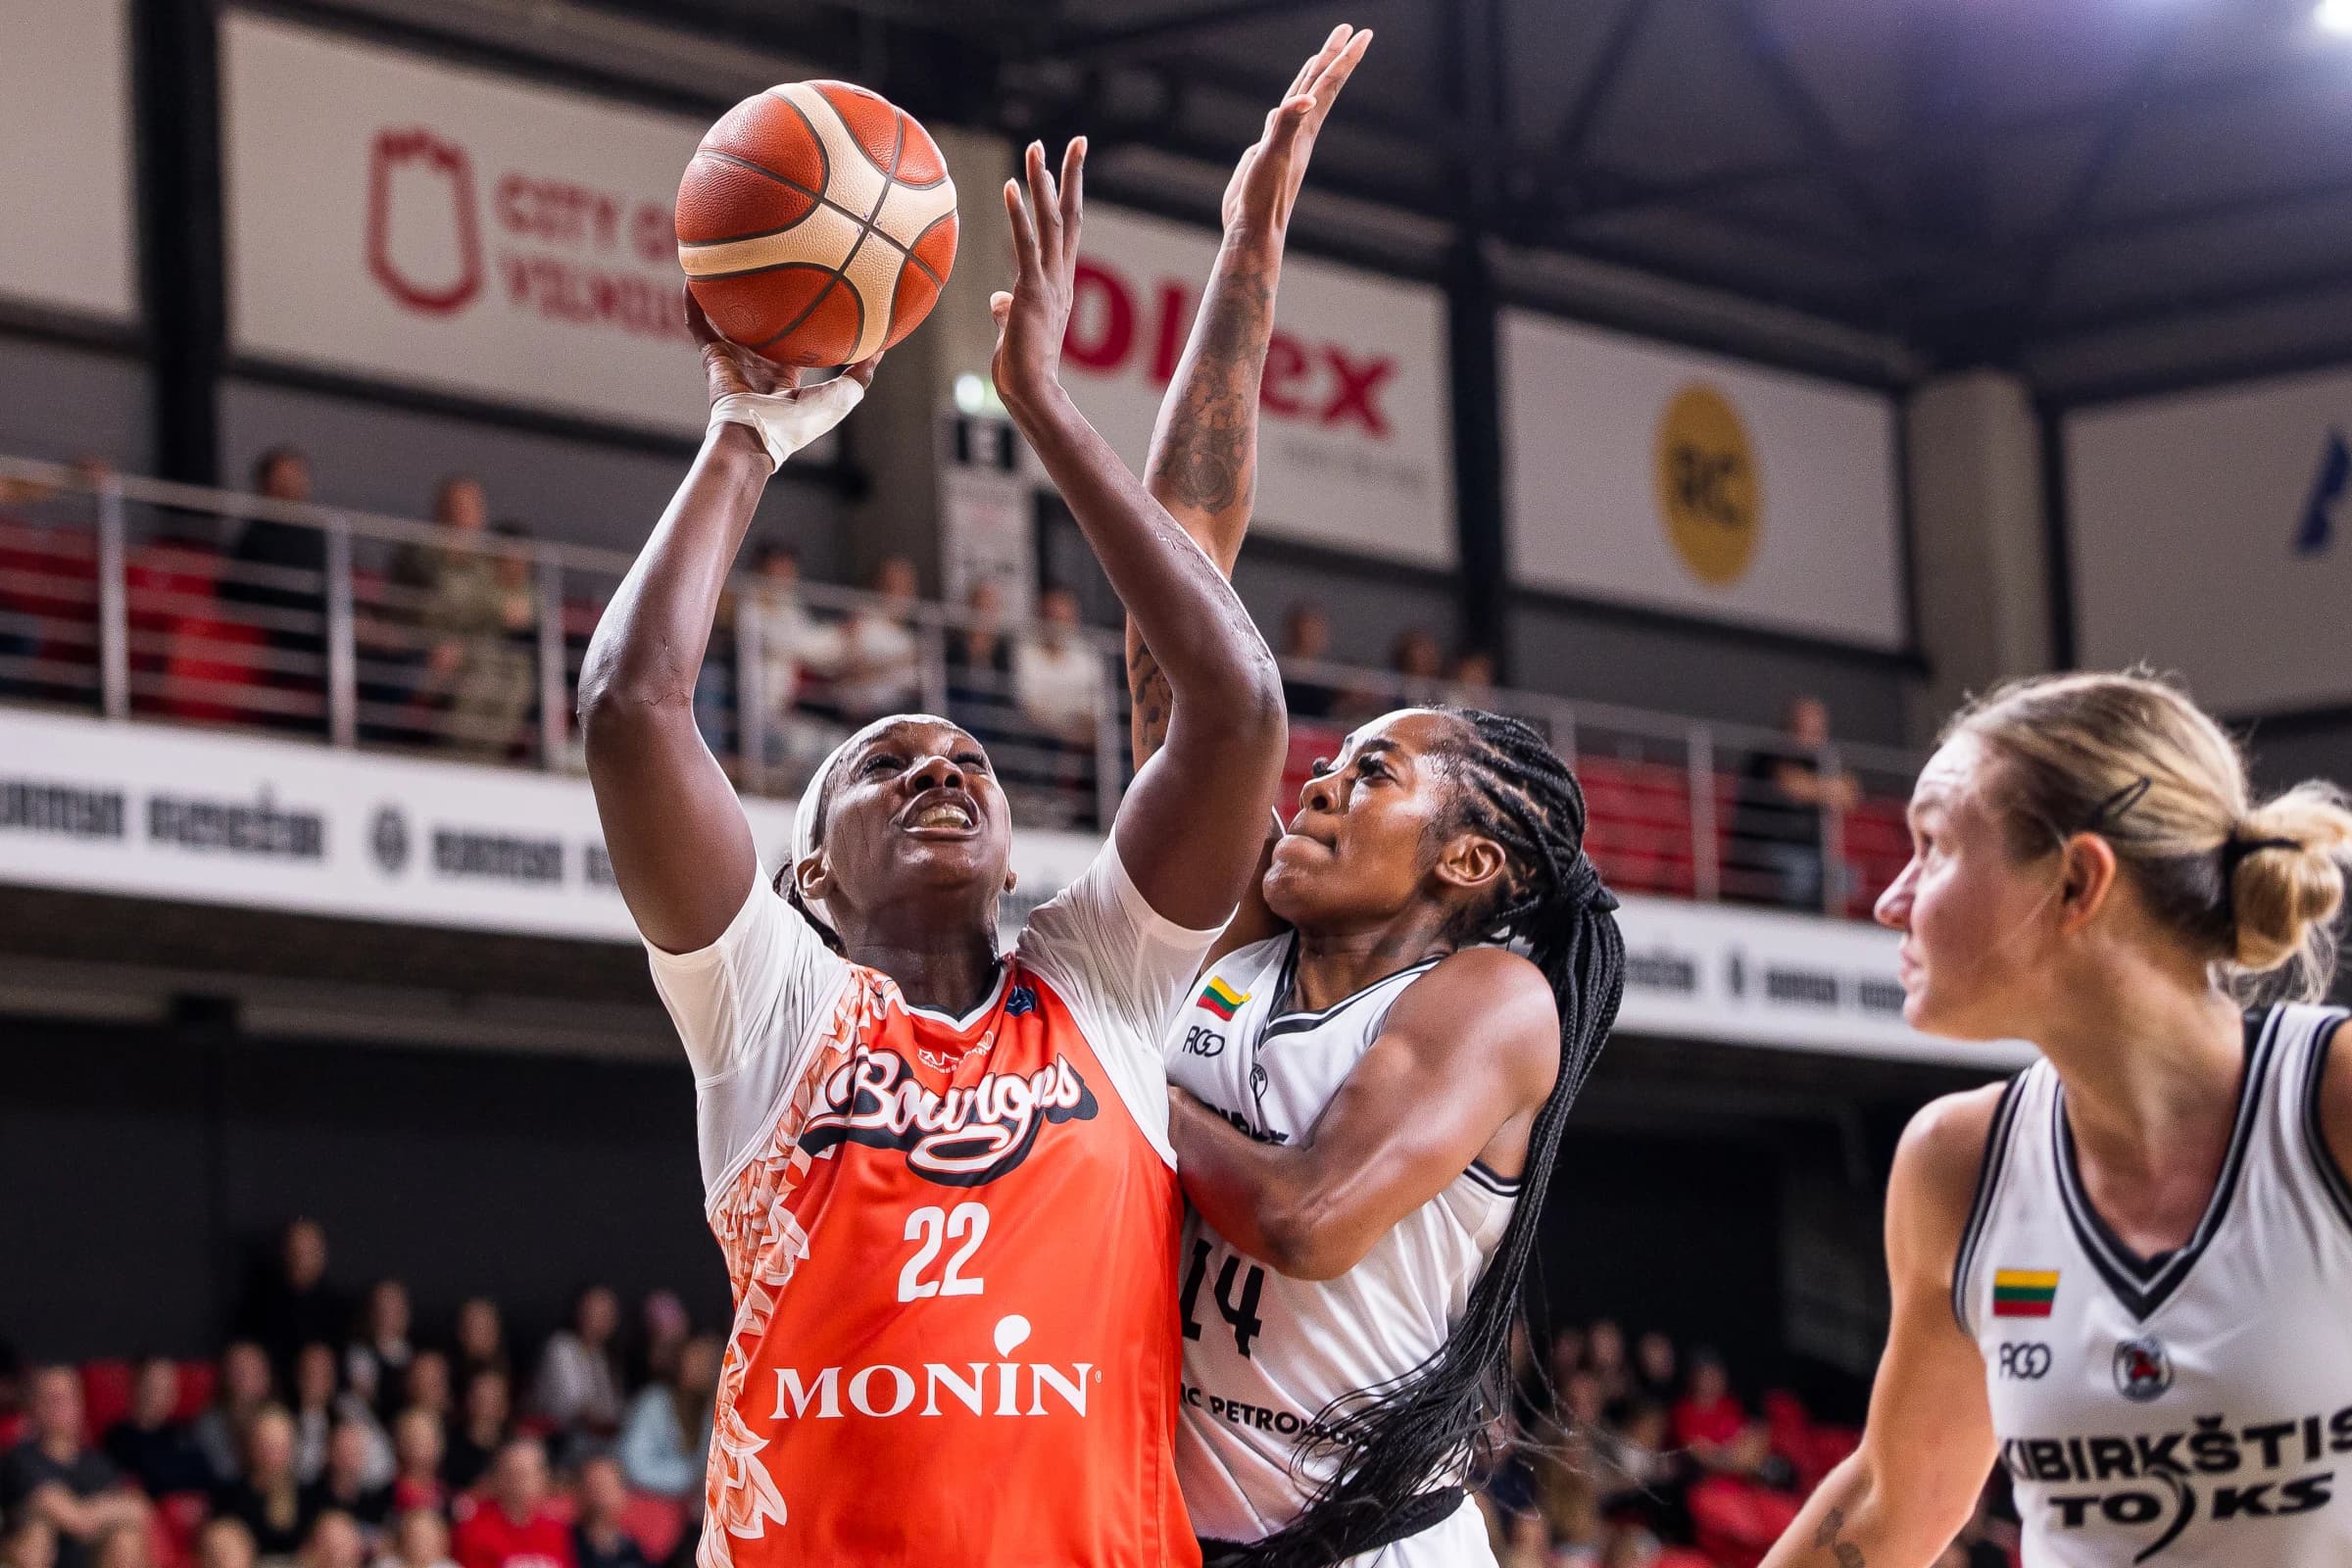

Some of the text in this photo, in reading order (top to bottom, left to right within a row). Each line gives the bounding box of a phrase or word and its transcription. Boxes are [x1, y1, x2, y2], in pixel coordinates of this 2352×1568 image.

[632, 202, 681, 263] O
[801, 1044, 1090, 1182] Bourges
[898, 1201, 990, 1302] 22
[1179, 1238, 1265, 1360] 14
